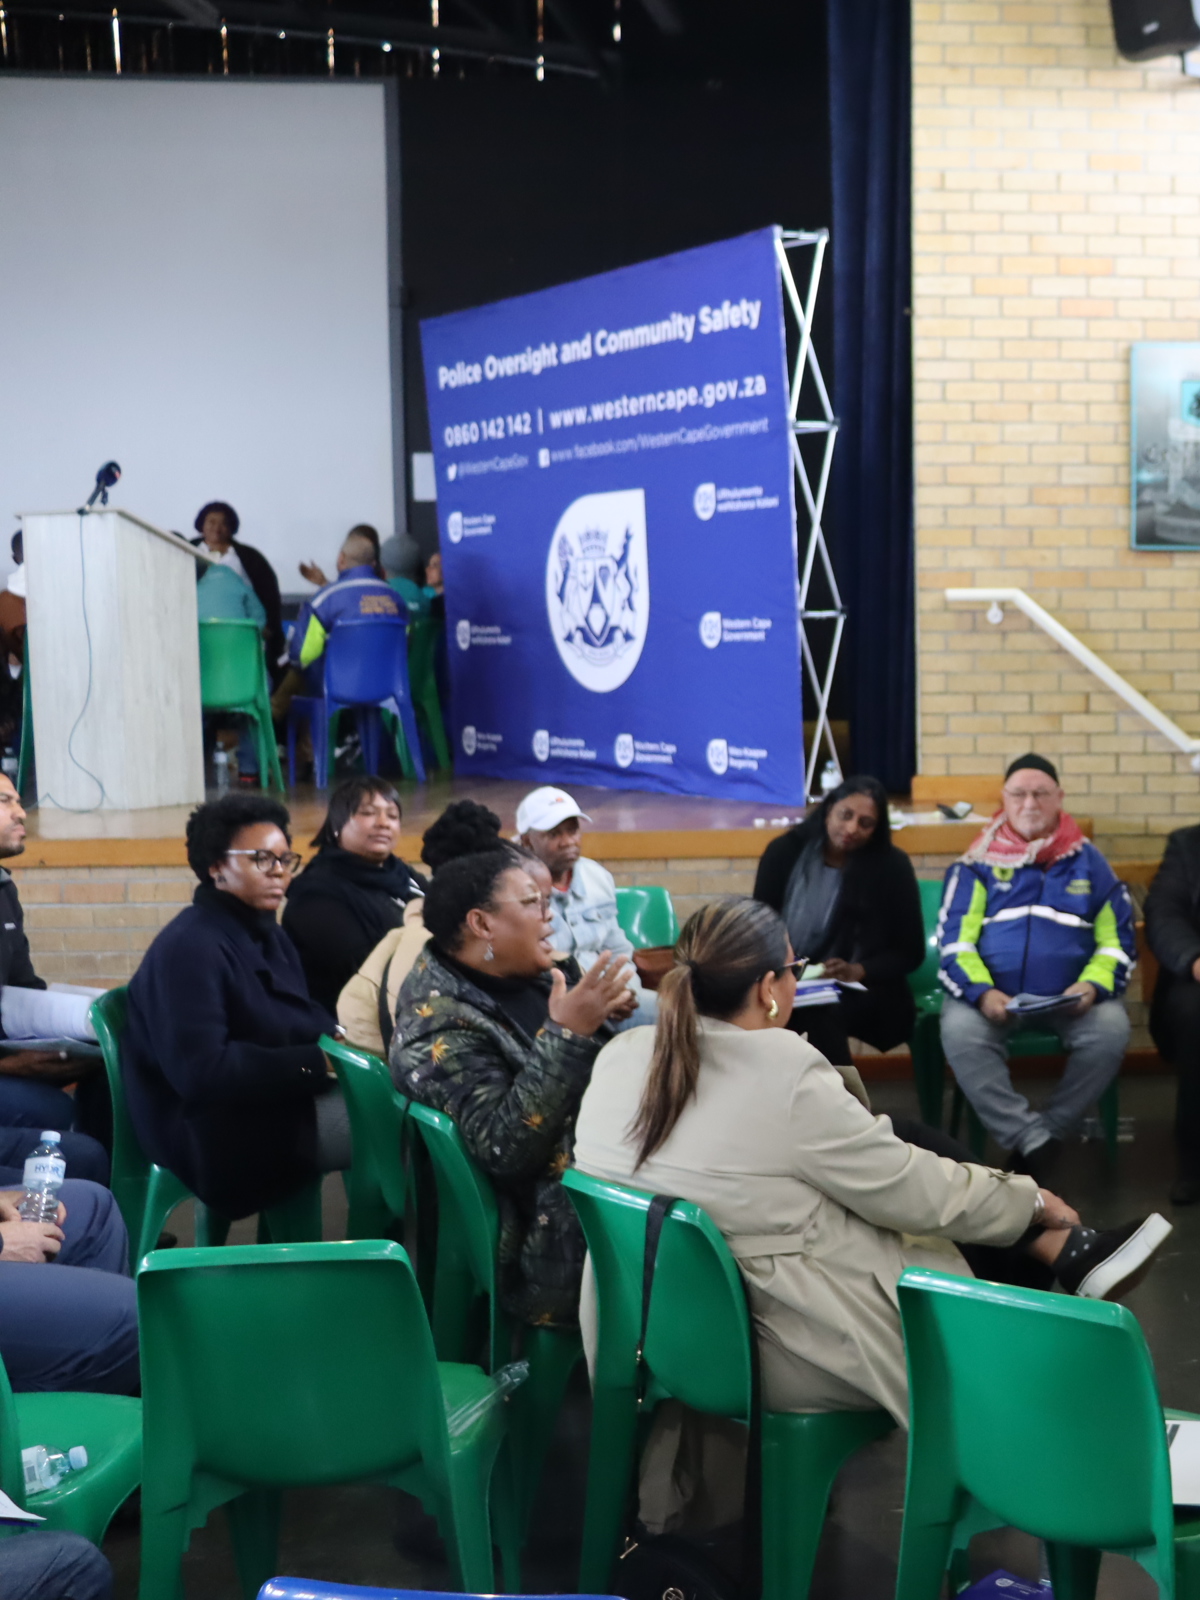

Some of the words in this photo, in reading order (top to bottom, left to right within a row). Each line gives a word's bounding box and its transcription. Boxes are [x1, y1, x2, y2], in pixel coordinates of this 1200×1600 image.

[438, 361, 482, 390] Police
[484, 341, 558, 381] Oversight
[560, 331, 592, 364] and
[594, 311, 696, 357] Community
[698, 298, 762, 334] Safety
[444, 421, 480, 448] 0860
[481, 417, 505, 441] 142
[506, 411, 532, 437] 142
[550, 374, 767, 430] www.westerncape.gov.za
